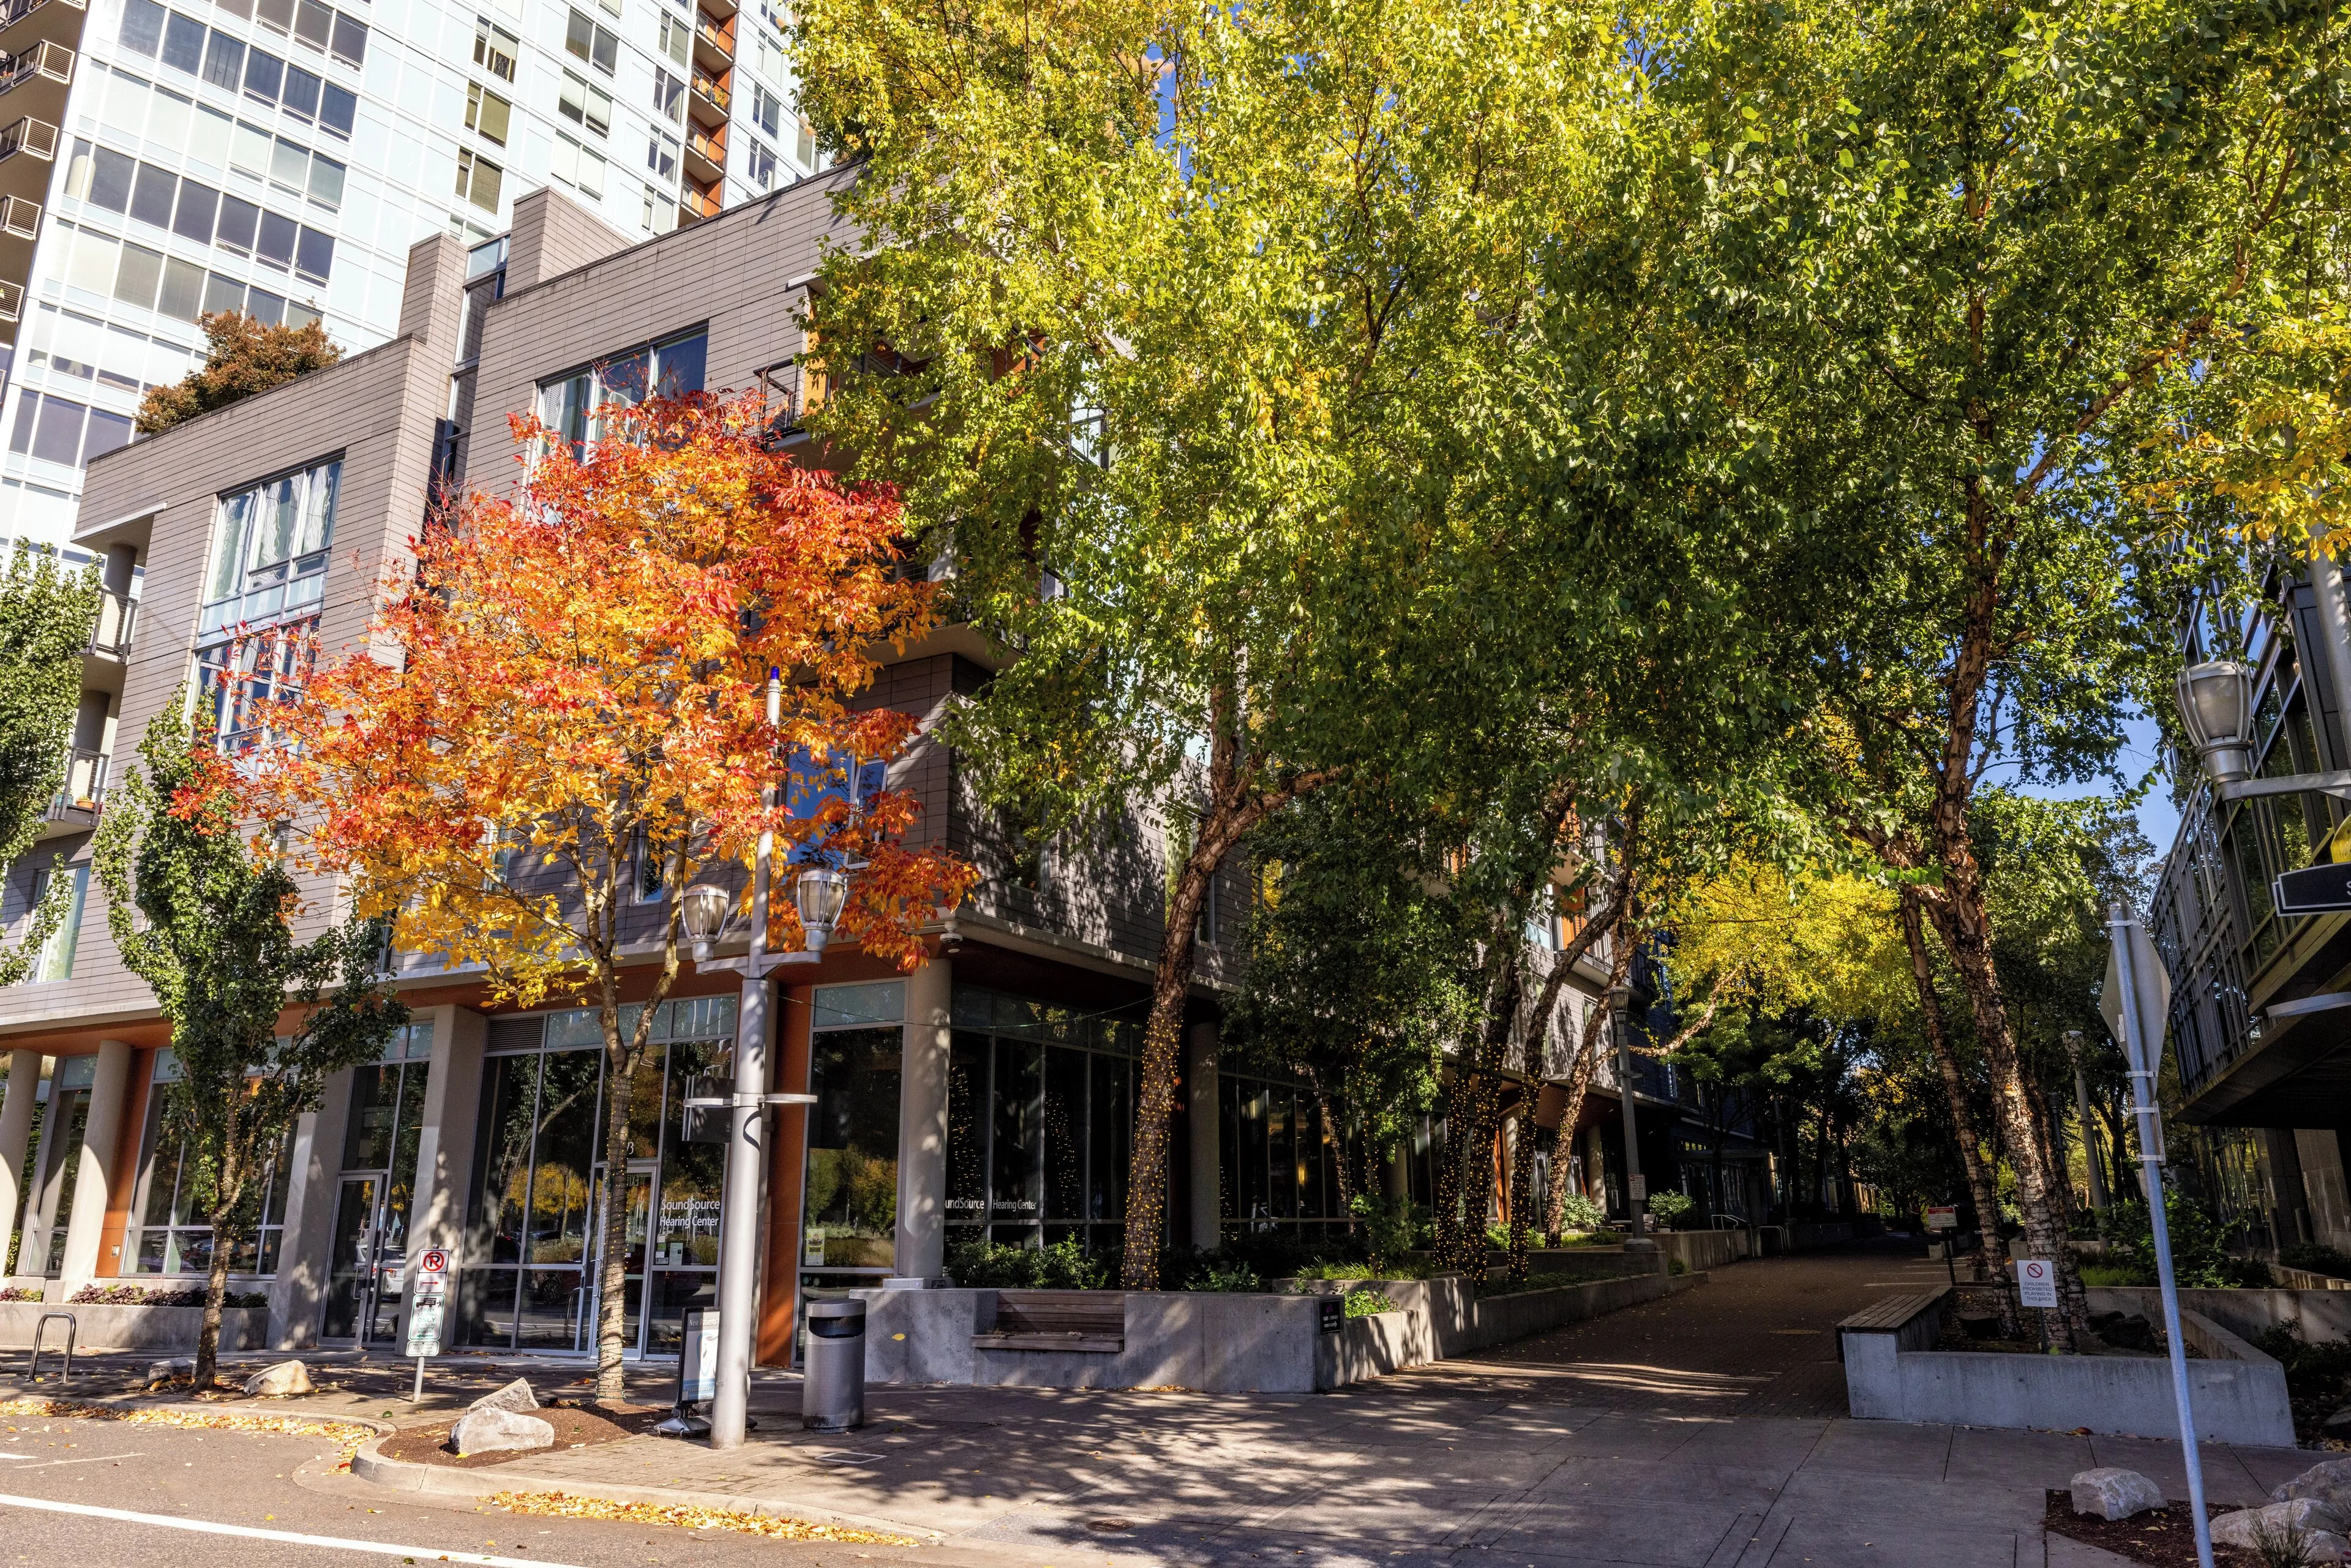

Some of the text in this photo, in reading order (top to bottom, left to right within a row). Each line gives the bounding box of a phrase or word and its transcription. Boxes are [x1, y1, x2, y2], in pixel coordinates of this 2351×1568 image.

[661, 1198, 720, 1210] SoundSource
[945, 1196, 1037, 1212] undSource Hearing Center
[659, 1216, 719, 1229] Hearing Center
[700, 1317, 718, 1326] Patients
